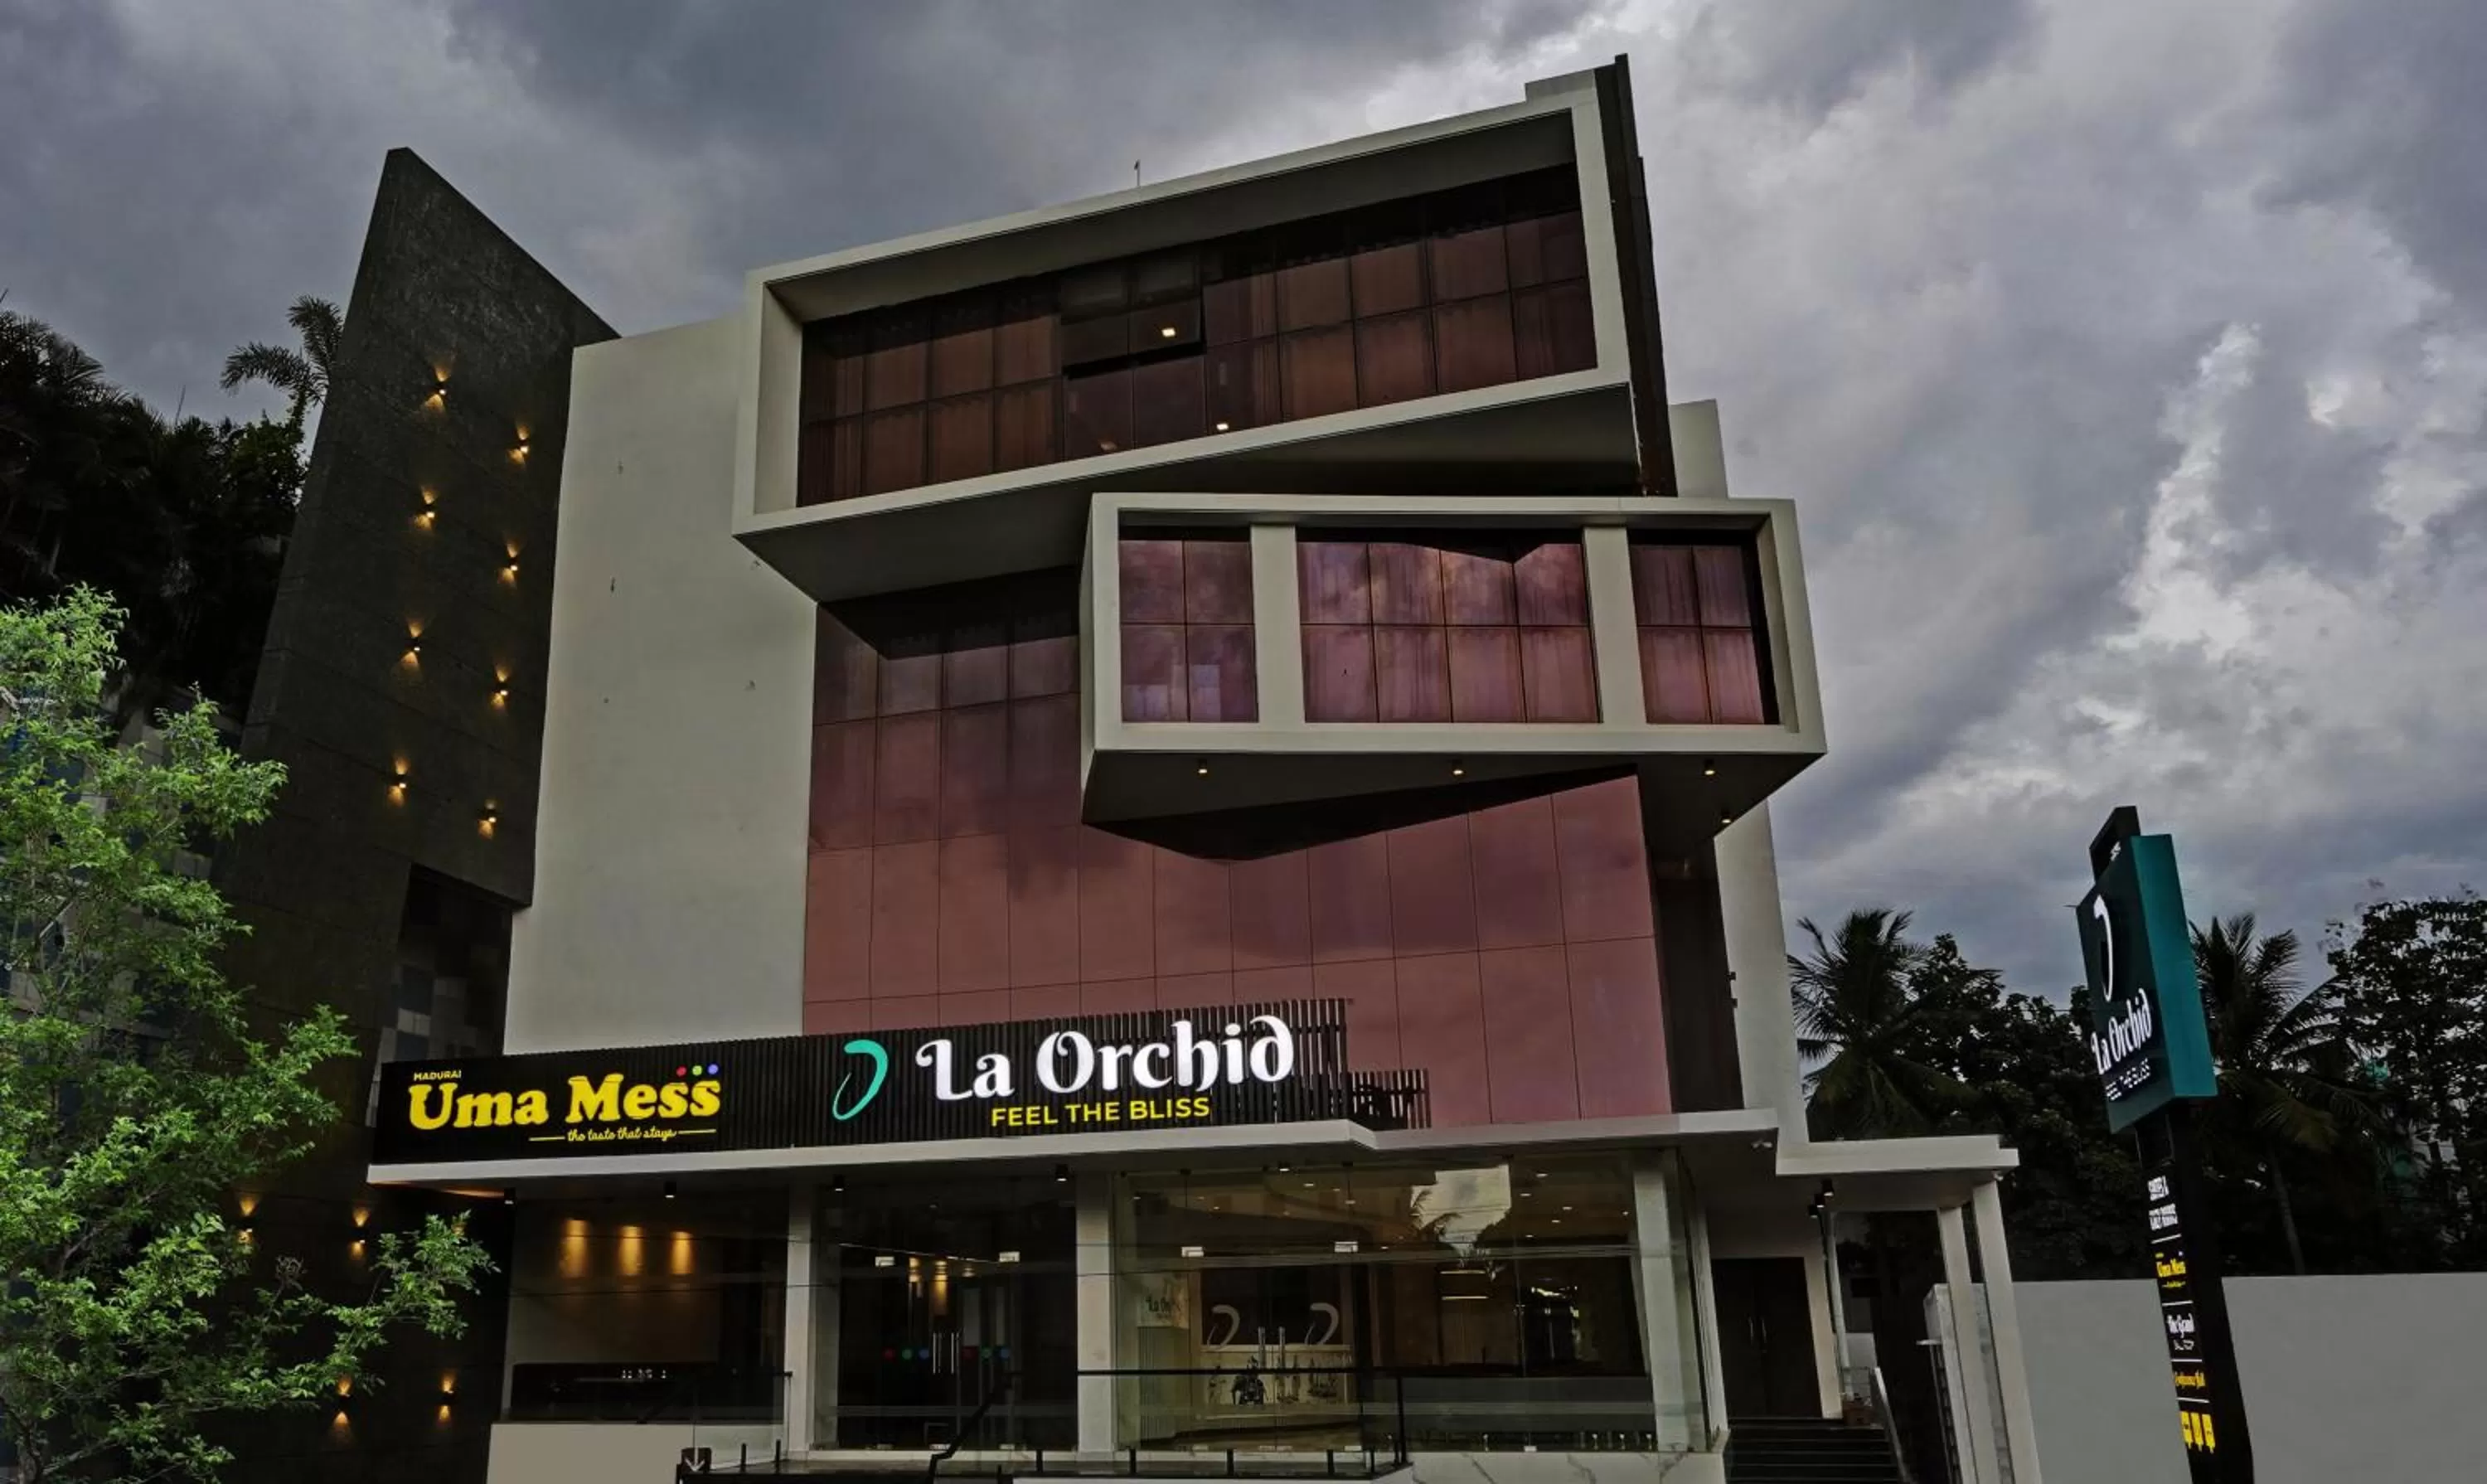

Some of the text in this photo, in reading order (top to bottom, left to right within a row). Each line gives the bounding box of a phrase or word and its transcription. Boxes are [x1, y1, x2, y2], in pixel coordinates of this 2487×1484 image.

[915, 1016, 1295, 1101] La Orchid
[2091, 1031, 2111, 1074] La
[414, 1069, 462, 1081] MADURAI
[409, 1073, 721, 1130] Uma Mess
[991, 1097, 1210, 1127] FEEL THE BLISS
[567, 1128, 585, 1142] the
[588, 1127, 615, 1142] taste
[616, 1126, 642, 1140] that
